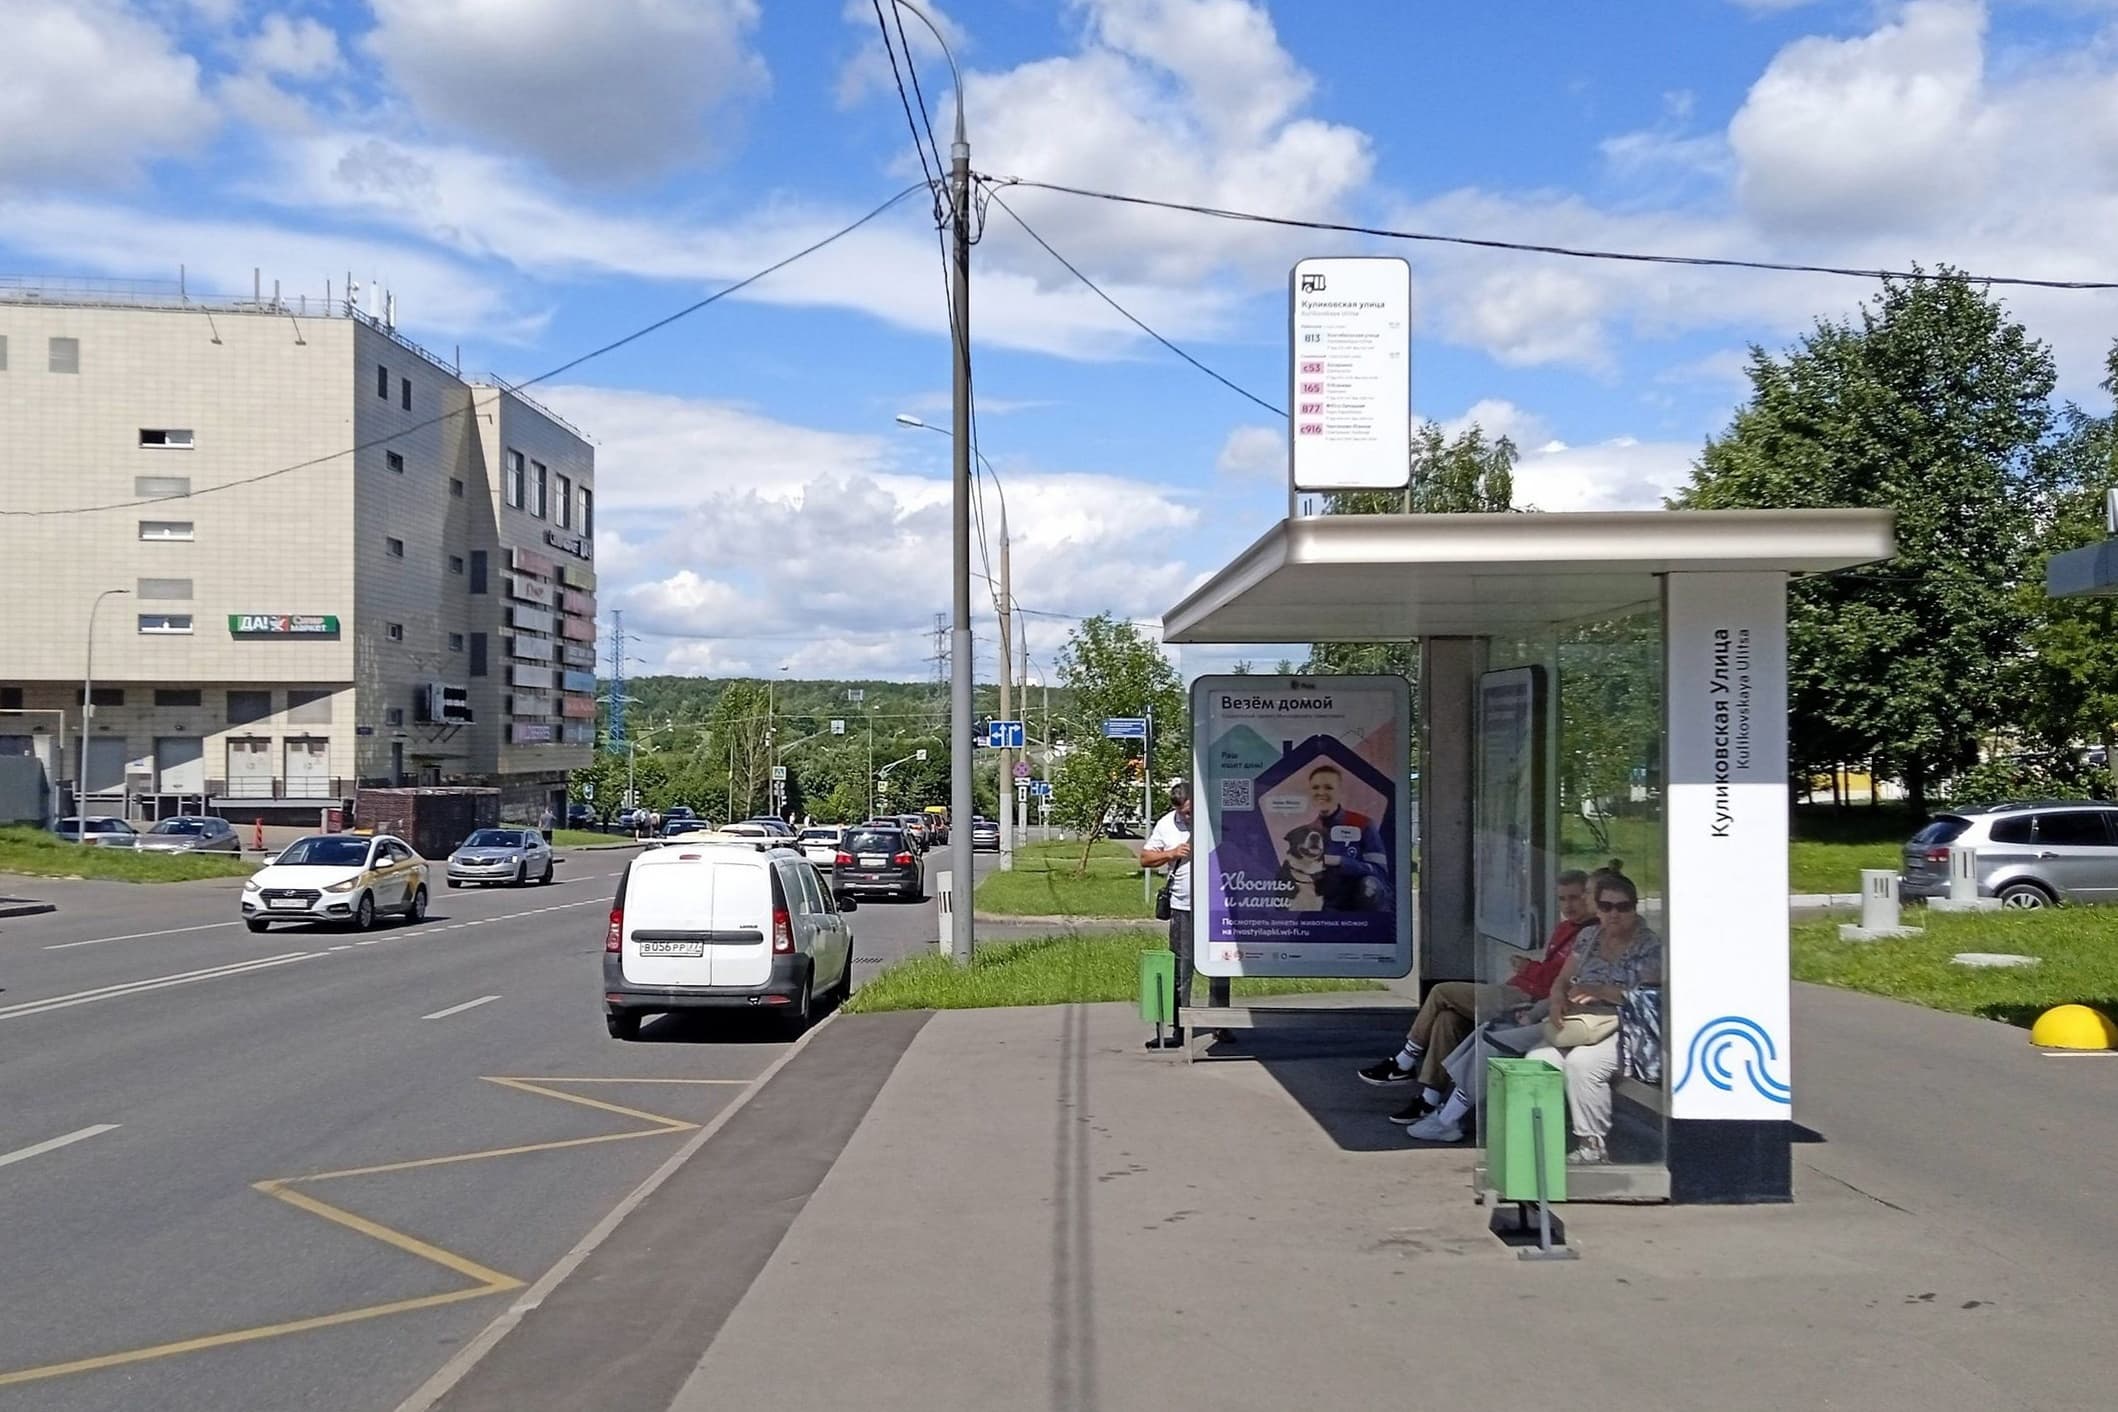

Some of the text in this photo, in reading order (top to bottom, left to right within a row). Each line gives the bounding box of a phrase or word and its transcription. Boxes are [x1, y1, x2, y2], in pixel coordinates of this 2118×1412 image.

[1301, 300, 1386, 309] Куликовская улица
[1304, 333, 1321, 343] 813
[1304, 384, 1320, 393] 165
[1302, 404, 1320, 414] 877
[240, 616, 269, 631] ДА!
[1221, 695, 1333, 712] Везём домой
[1736, 628, 1753, 770] Kulikovskaya Ulitsa
[1710, 628, 1734, 838] Куликовская Улица
[1220, 871, 1295, 892] Хвосты
[1224, 896, 1293, 909] и лапки
[1221, 918, 1270, 928] Посмотреть
